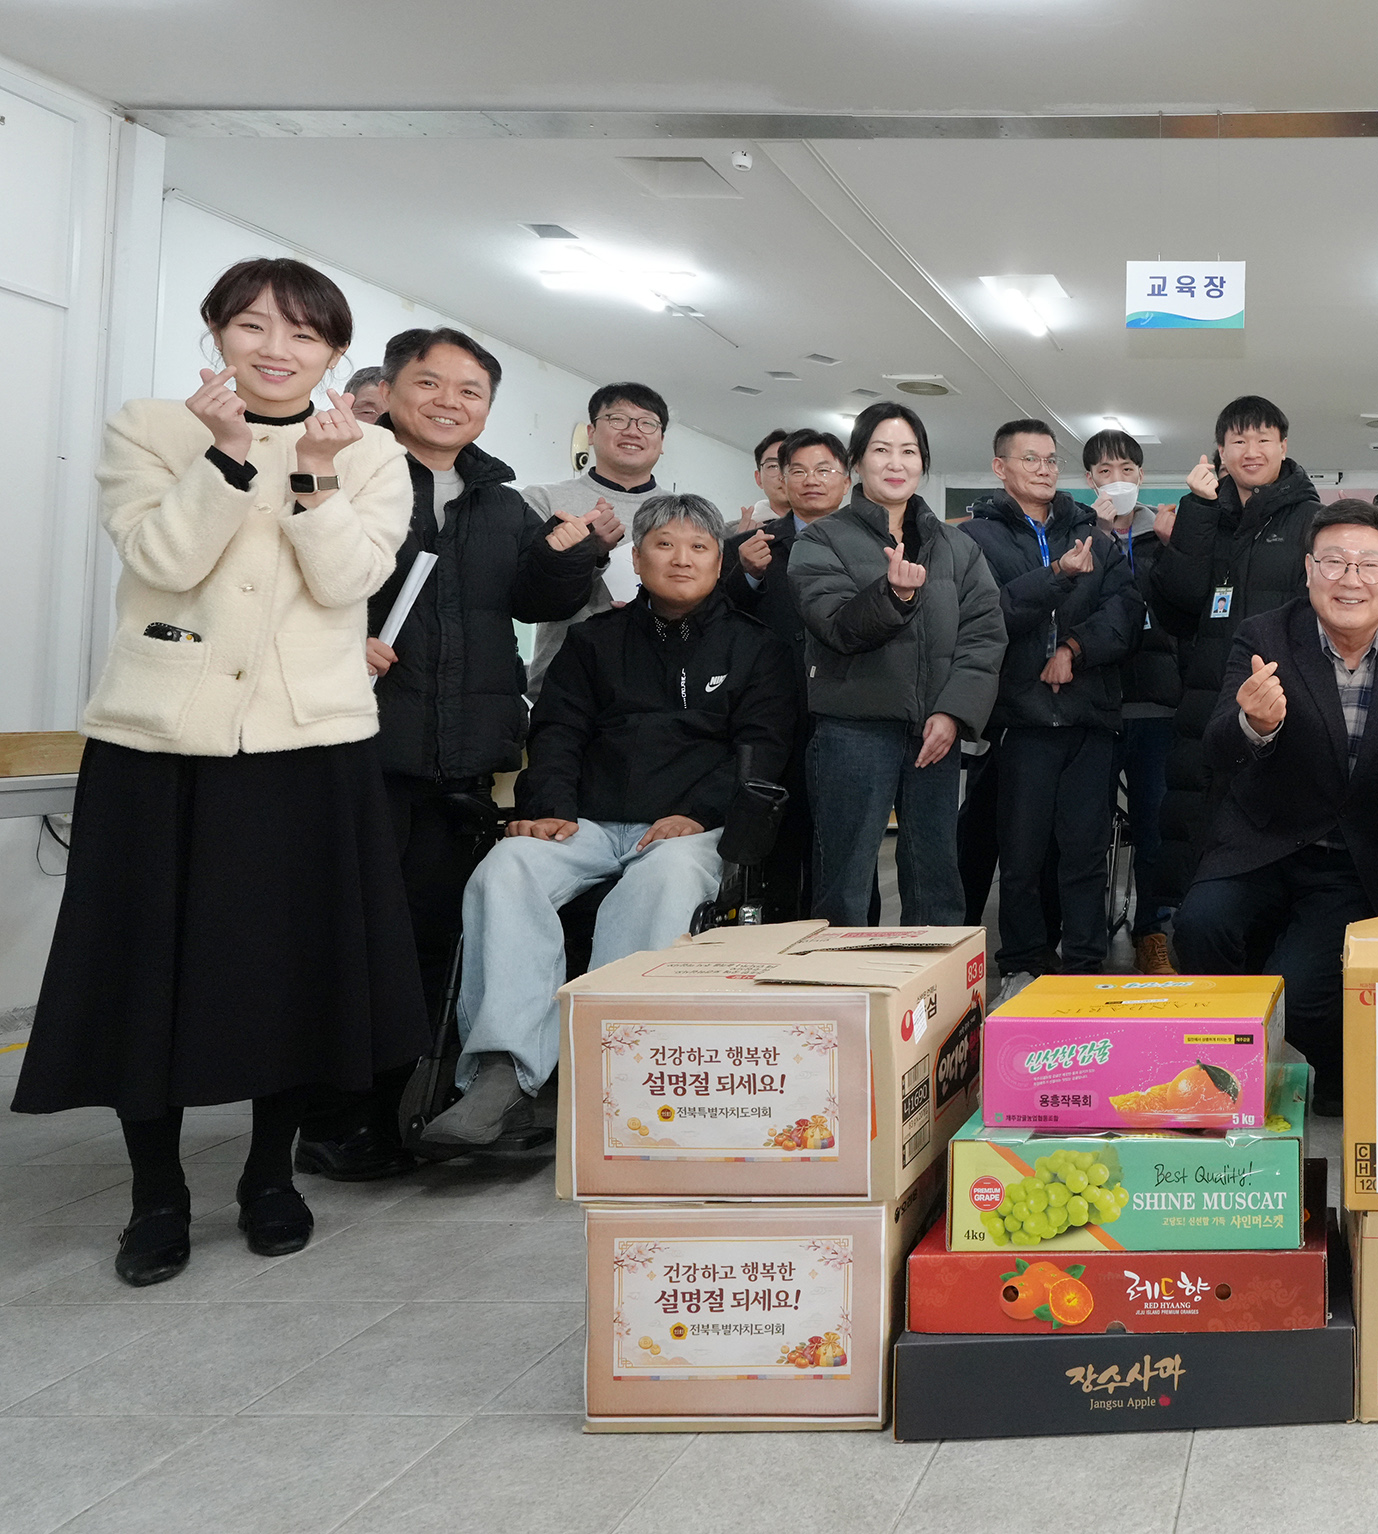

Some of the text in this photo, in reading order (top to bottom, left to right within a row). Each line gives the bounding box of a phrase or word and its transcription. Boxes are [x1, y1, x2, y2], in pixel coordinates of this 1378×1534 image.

[1147, 275, 1226, 299] 교육장
[967, 961, 977, 983] 83
[650, 1045, 780, 1066] 건강하고 행복한
[1024, 1044, 1078, 1074] 신선한
[1077, 1038, 1113, 1066] 감귤
[642, 1071, 786, 1097] 설명절 되세요!
[1039, 1094, 1092, 1107] 용흥작목회
[676, 1106, 772, 1119] 전북특별자치도의회
[1232, 1113, 1255, 1126] 5 kg
[1359, 1146, 1368, 1158] C
[1154, 1161, 1253, 1187] Best Quality!
[1359, 1163, 1368, 1174] H
[974, 1194, 1000, 1202] GRAPE
[1132, 1191, 1288, 1211] SHINE MUSCAT
[1162, 1216, 1186, 1226] 고당도!
[1211, 1216, 1226, 1226] 가득
[1230, 1214, 1284, 1228] 샤인머스켓
[964, 1229, 985, 1242] 4kg
[663, 1261, 796, 1284] 건강하고 행복한
[1123, 1270, 1211, 1302] 레드향
[654, 1288, 801, 1314] 설명절 되세요!
[689, 1323, 785, 1336] 전북특별자치도의회
[1065, 1354, 1186, 1394] 장수사과
[1090, 1397, 1156, 1410] Jangsu Apple
